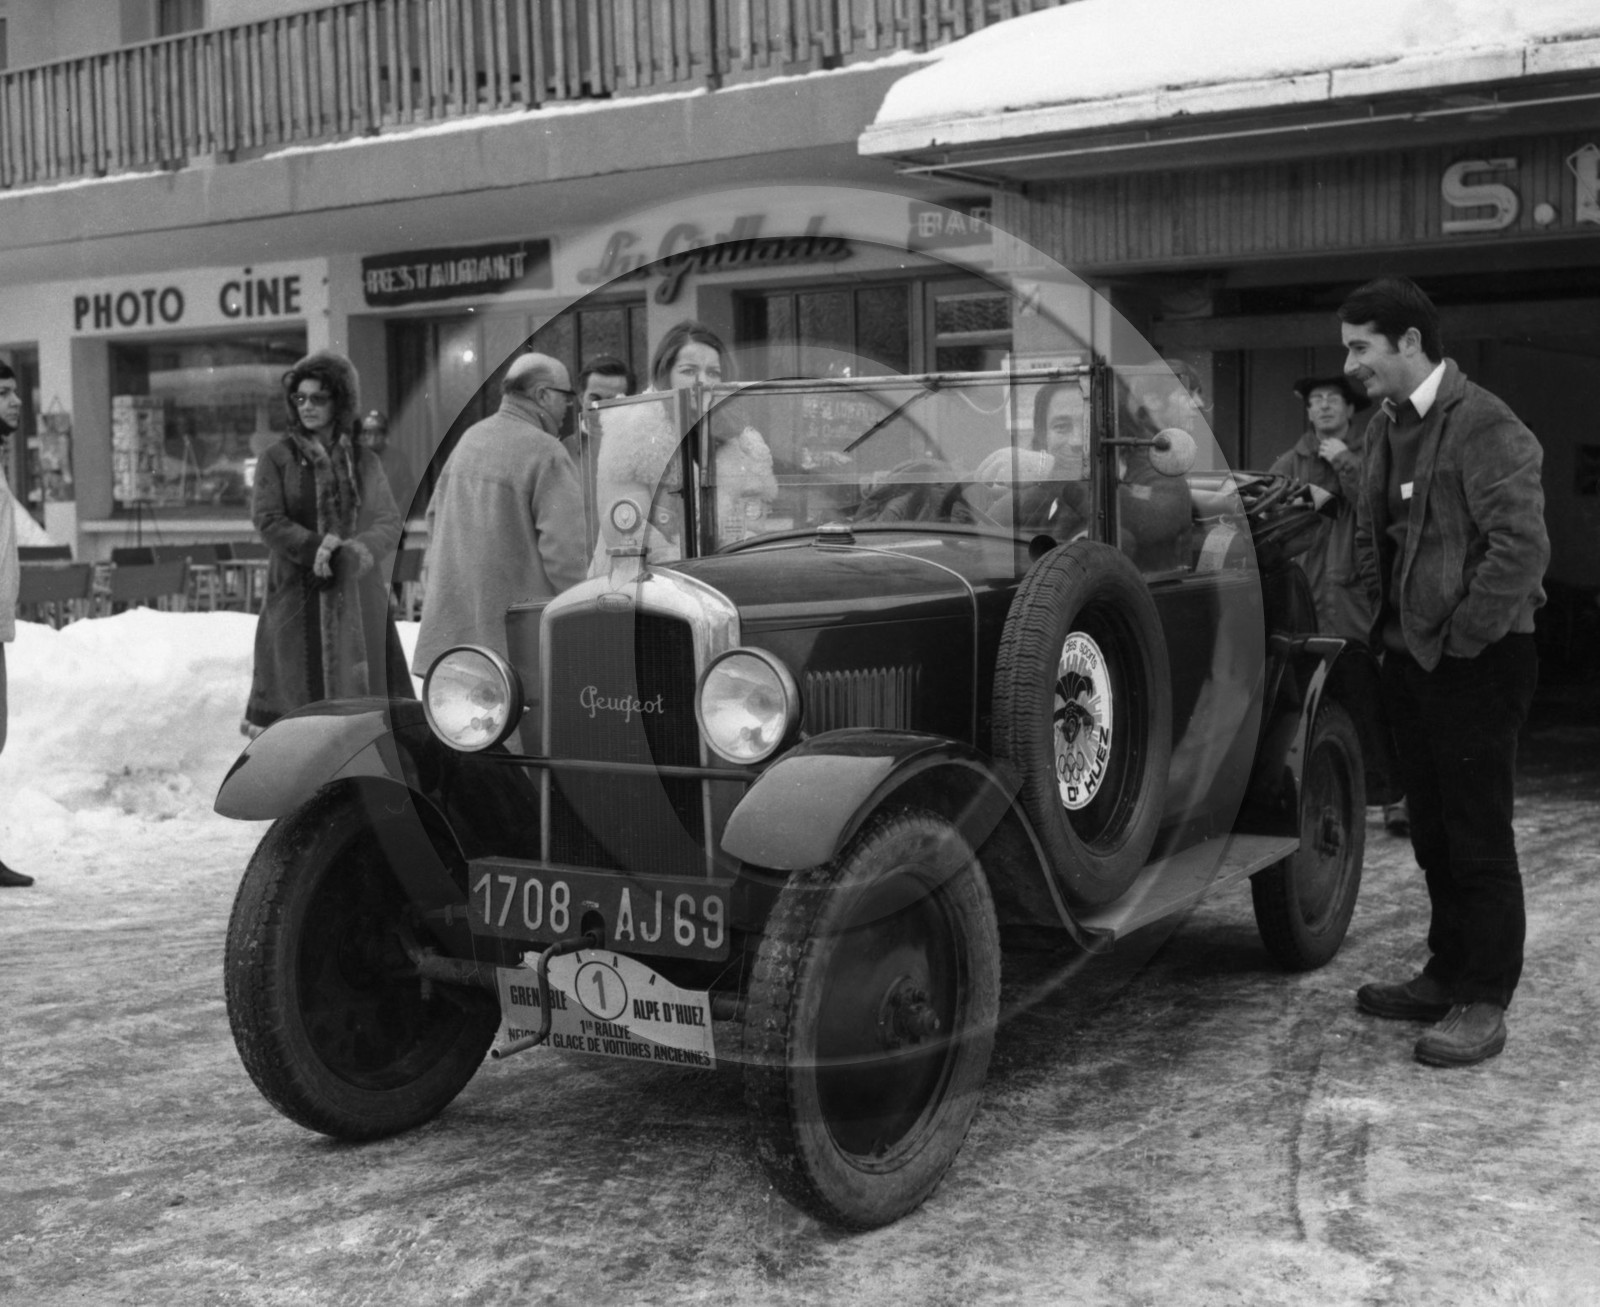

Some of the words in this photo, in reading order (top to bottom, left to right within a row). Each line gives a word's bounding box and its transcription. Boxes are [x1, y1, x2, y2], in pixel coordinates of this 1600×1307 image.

[366, 252, 527, 294] RESTAURANT
[73, 286, 185, 330] PHOTO
[1079, 642, 1098, 670] sports
[580, 685, 664, 723] Peugeot
[473, 873, 571, 934] 1708
[510, 985, 568, 1011] GRENBLE
[592, 969, 607, 1010] 1
[594, 1021, 631, 1040] RALLYE
[633, 999, 661, 1021] ALPE
[662, 1002, 706, 1027] D'HUEZ
[553, 1033, 585, 1051] GLACE
[587, 1037, 602, 1053] DE
[602, 1038, 651, 1059] VOITURES
[654, 1045, 711, 1067] ANCIENNES
